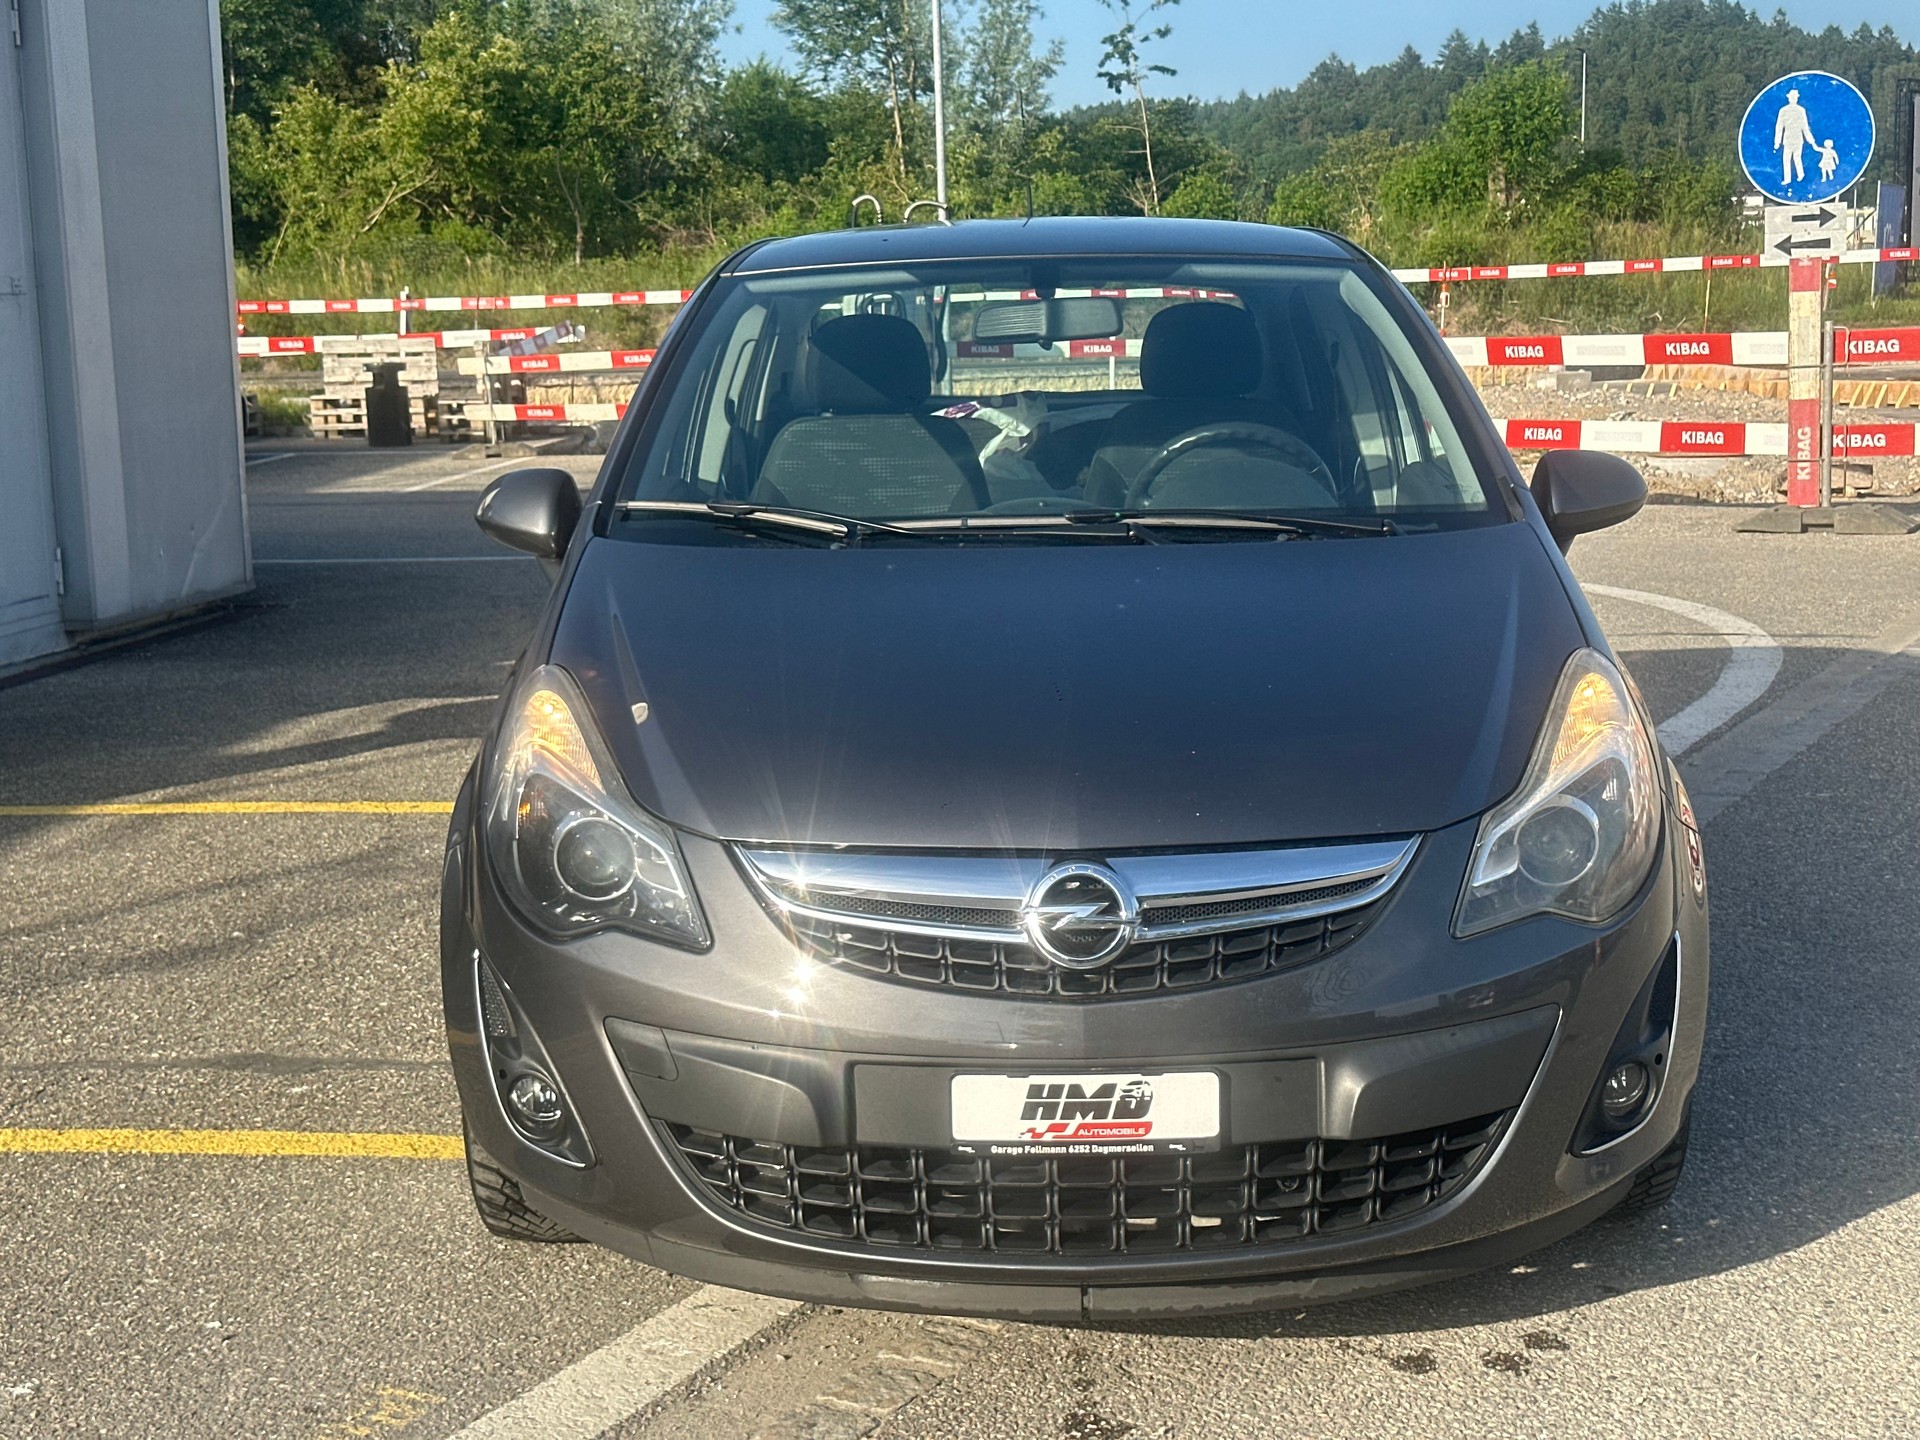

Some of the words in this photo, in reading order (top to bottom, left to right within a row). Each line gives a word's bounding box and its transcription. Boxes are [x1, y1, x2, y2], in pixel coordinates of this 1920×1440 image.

[970, 345, 1000, 354] KIBAG
[1083, 344, 1113, 354] KIBAG
[1504, 345, 1544, 358] KIBAG
[1665, 342, 1710, 356] KIBAG
[1523, 427, 1563, 441] KIBAG
[1681, 431, 1724, 444] KIBAG
[1832, 433, 1886, 448] KIBAG
[1796, 426, 1812, 481] KIBAG
[1077, 1127, 1146, 1136] AUTOMOBILE
[990, 1145, 1024, 1155] Garage
[1068, 1144, 1091, 1154] 6252
